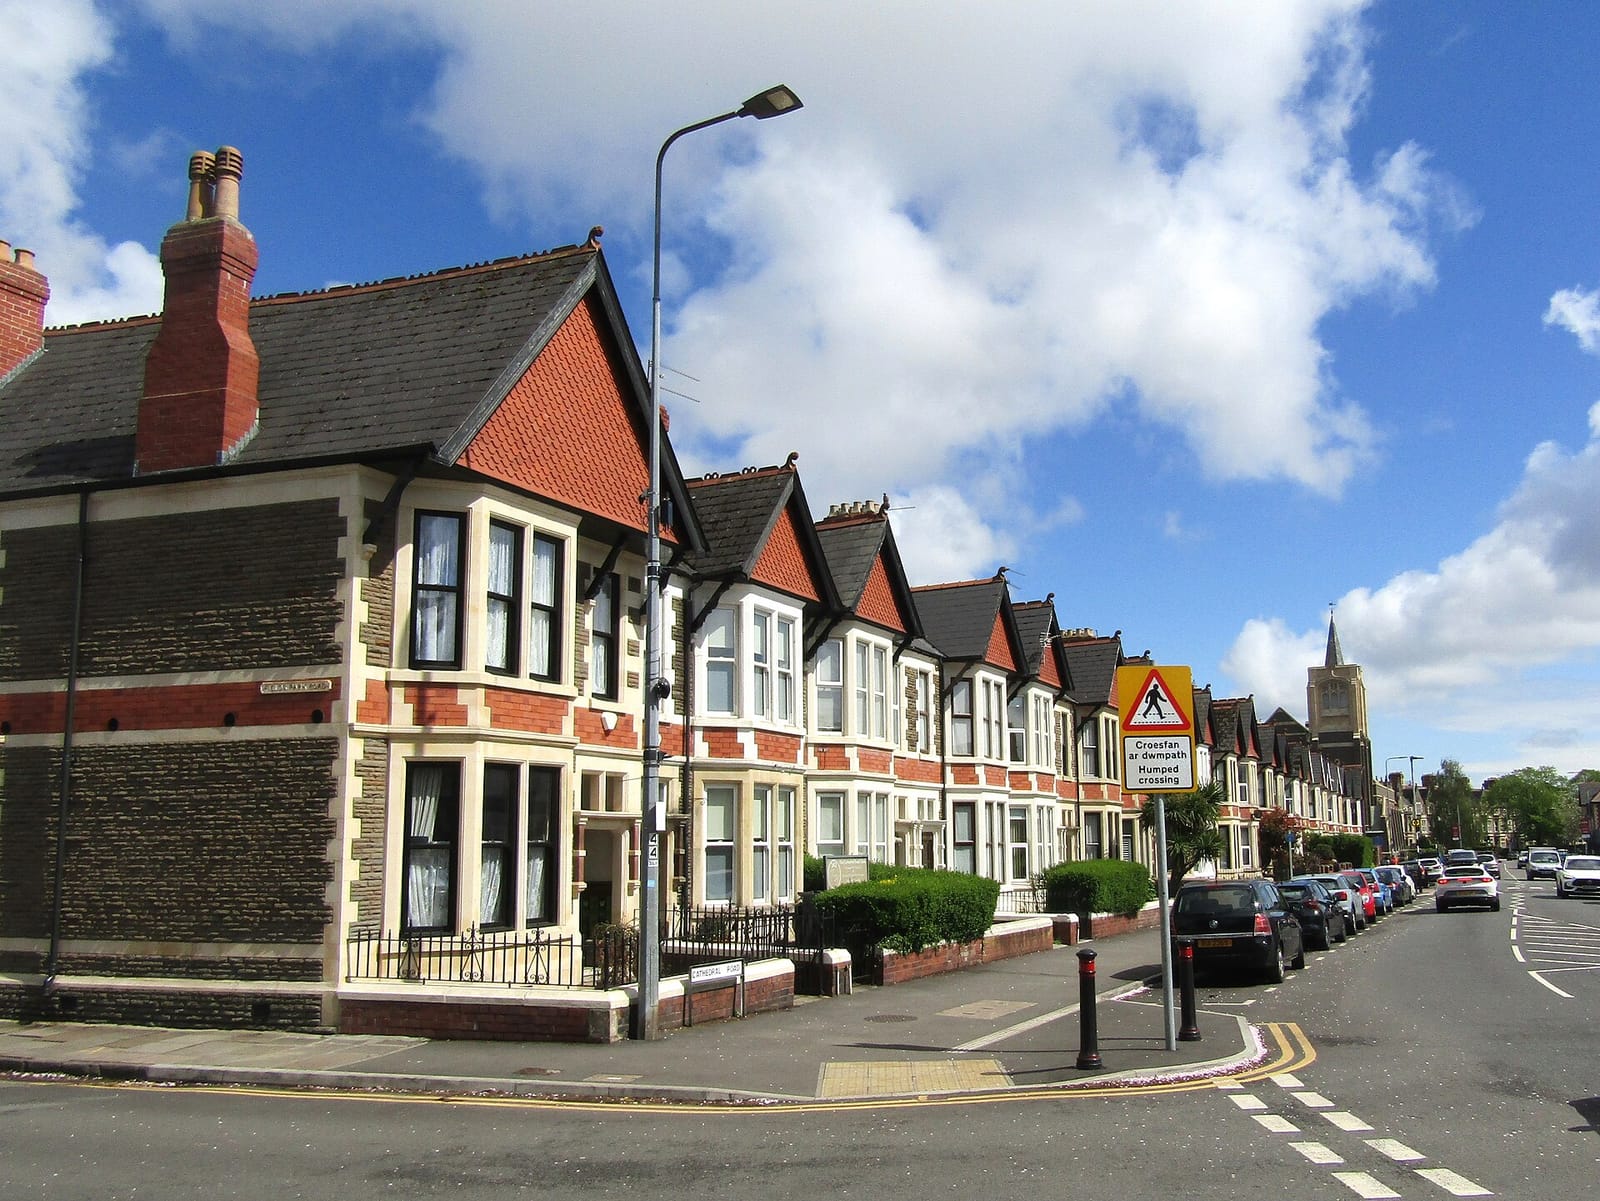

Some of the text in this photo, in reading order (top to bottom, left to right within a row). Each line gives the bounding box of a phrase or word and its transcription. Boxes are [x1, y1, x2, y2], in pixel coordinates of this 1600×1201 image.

[1136, 740, 1180, 749] Croesfan
[1142, 751, 1187, 760] dwmpath
[1138, 765, 1179, 775] Humped
[1138, 776, 1179, 785] crossing
[650, 848, 656, 857] 4
[692, 964, 740, 978] CATHEDRAL ROAD
